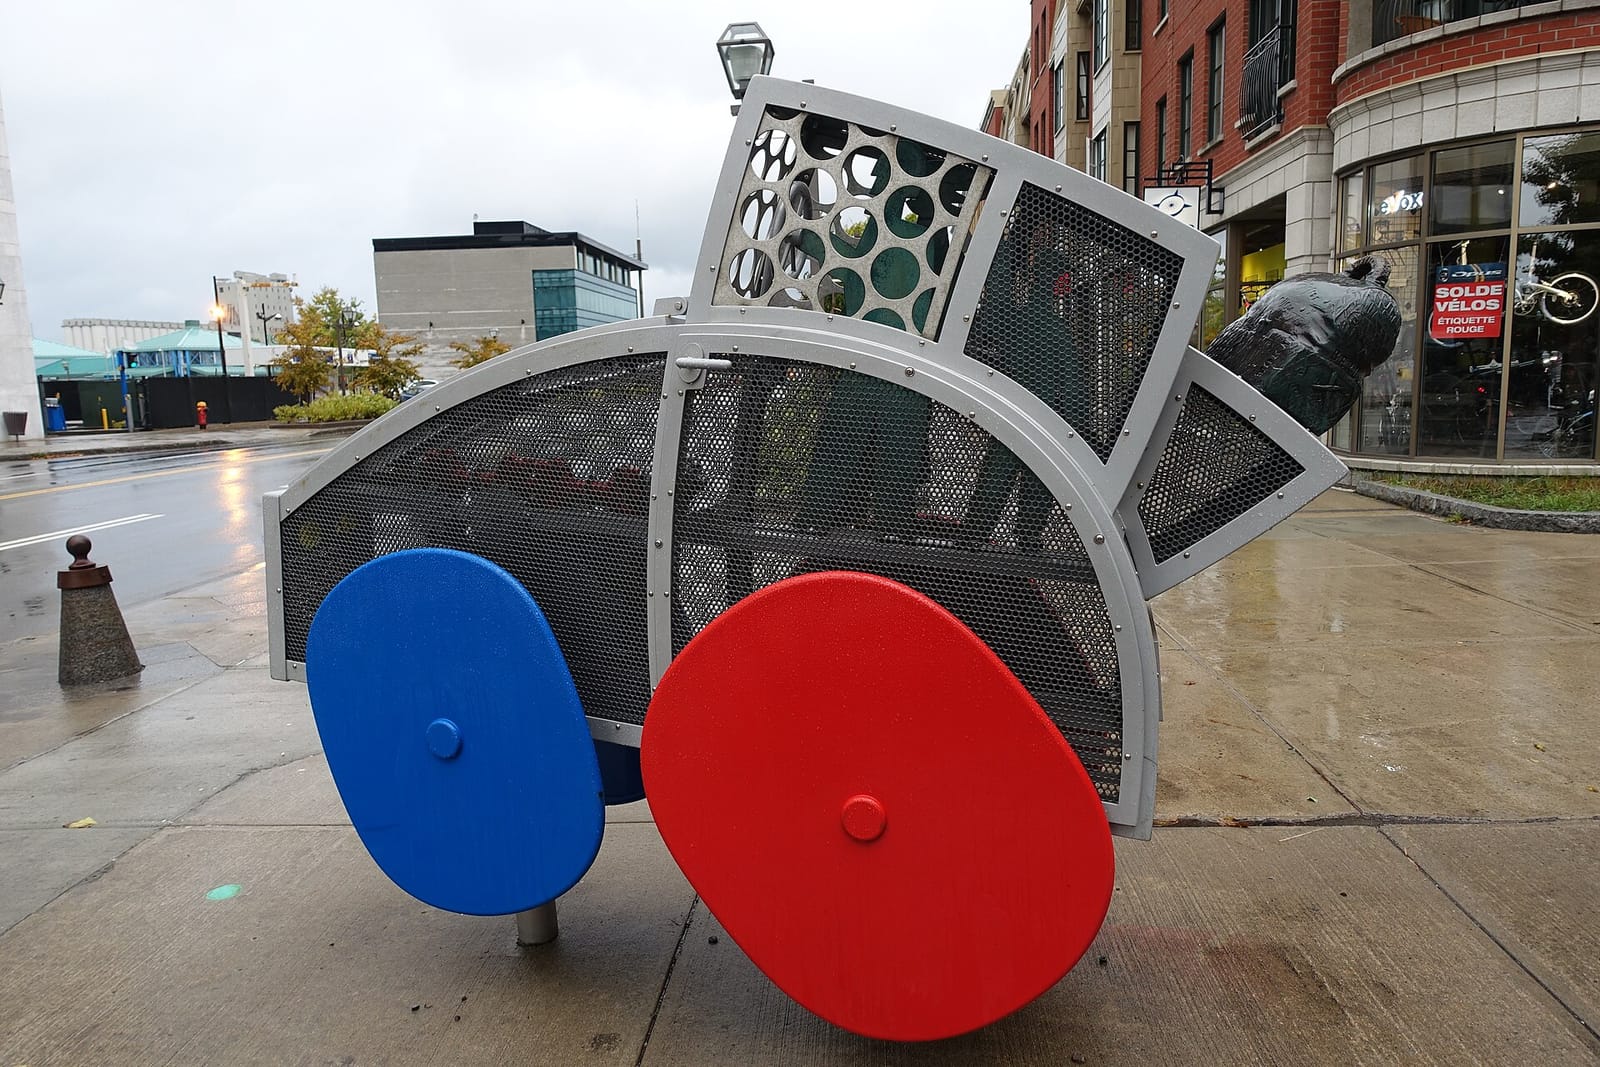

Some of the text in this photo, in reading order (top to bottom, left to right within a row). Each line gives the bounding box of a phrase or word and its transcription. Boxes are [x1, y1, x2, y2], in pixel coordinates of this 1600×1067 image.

[1435, 285, 1503, 298] SOLDE
[1435, 298, 1500, 312] VÉLOS
[1438, 316, 1496, 325] ÉTIQUETTE
[1446, 325, 1485, 334] ROUGE
